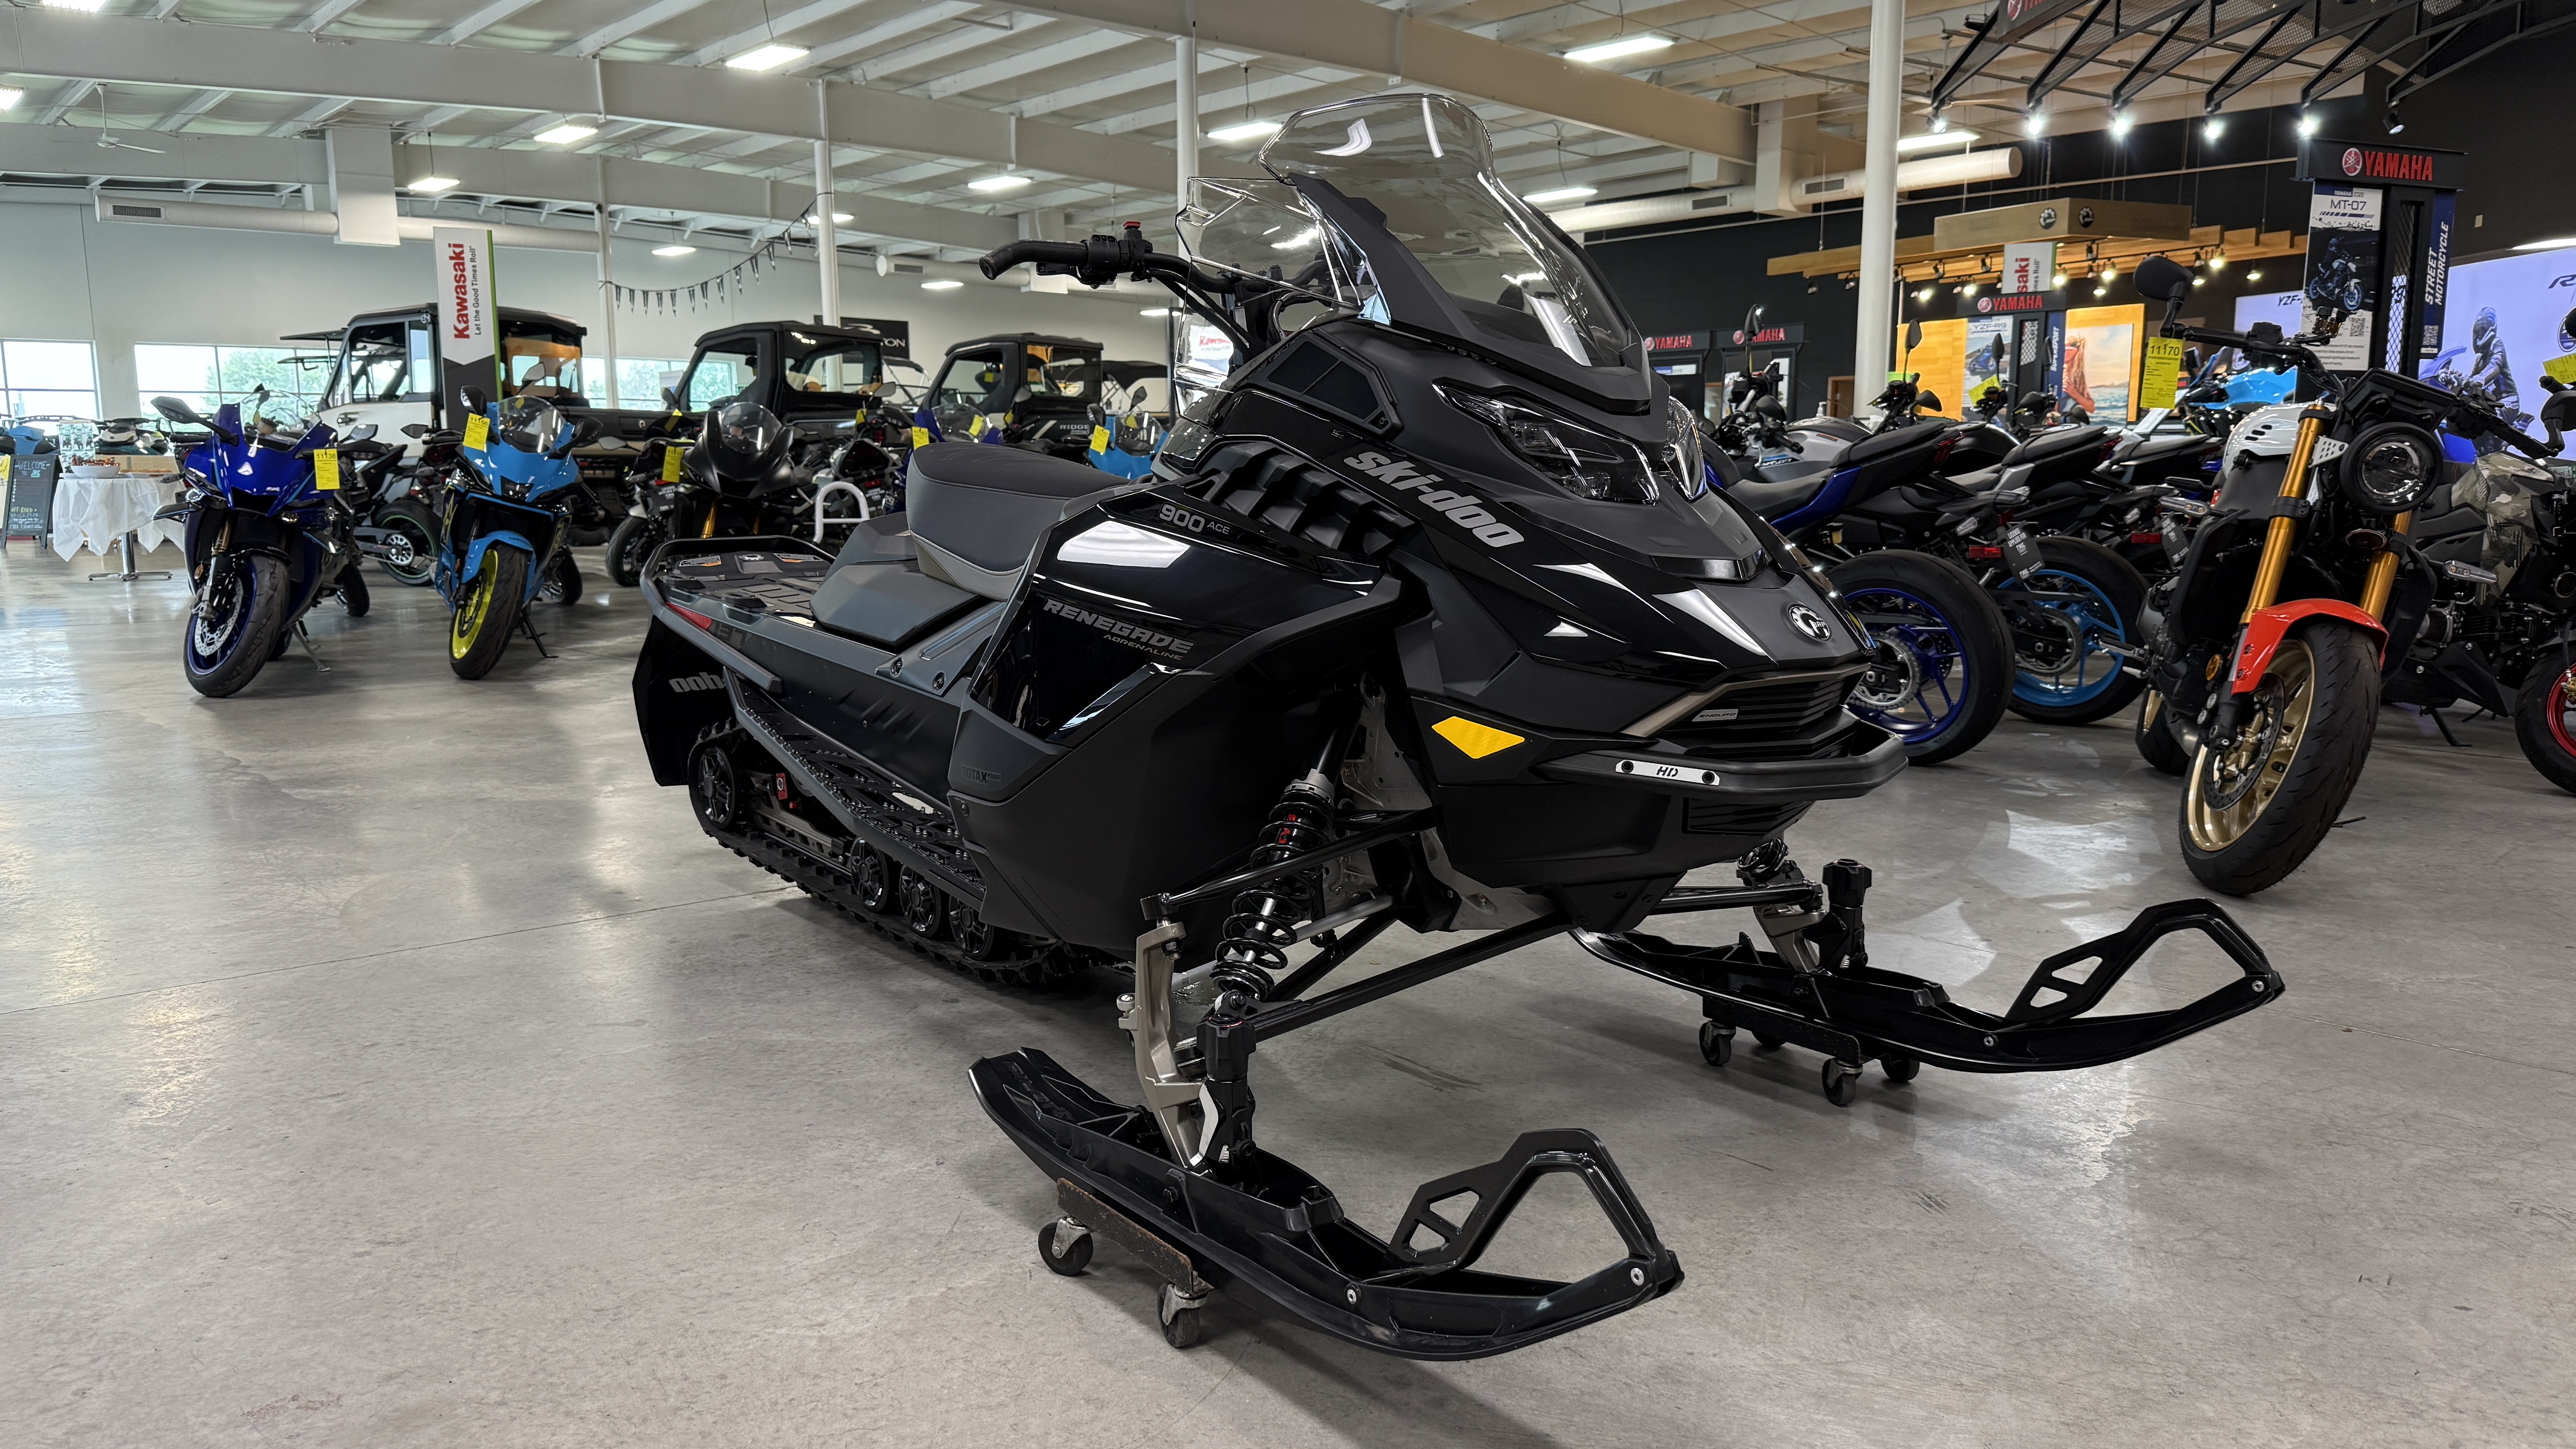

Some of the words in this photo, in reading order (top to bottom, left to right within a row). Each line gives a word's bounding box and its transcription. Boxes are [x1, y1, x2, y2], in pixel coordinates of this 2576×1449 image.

[2364, 151, 2433, 181] YAMAHA
[2331, 199, 2367, 211] MT-07
[2015, 258, 2030, 293] saki
[2425, 247, 2437, 305] STREET
[2435, 221, 2449, 305] MOTORCYCLE
[448, 243, 470, 339] Kawasaki
[1993, 295, 2043, 312] YAMAHA
[2278, 295, 2302, 306] YZF-
[1655, 336, 1693, 350] YAMAHA
[1751, 328, 1785, 343] AMAHA
[2150, 345, 2180, 356] 11170
[1159, 504, 1205, 533] 900
[1207, 521, 1231, 535] ACE
[1043, 598, 1195, 654] RENEGADE
[1103, 634, 1184, 661] ADRENALINE
[1656, 766, 1679, 777] HD
